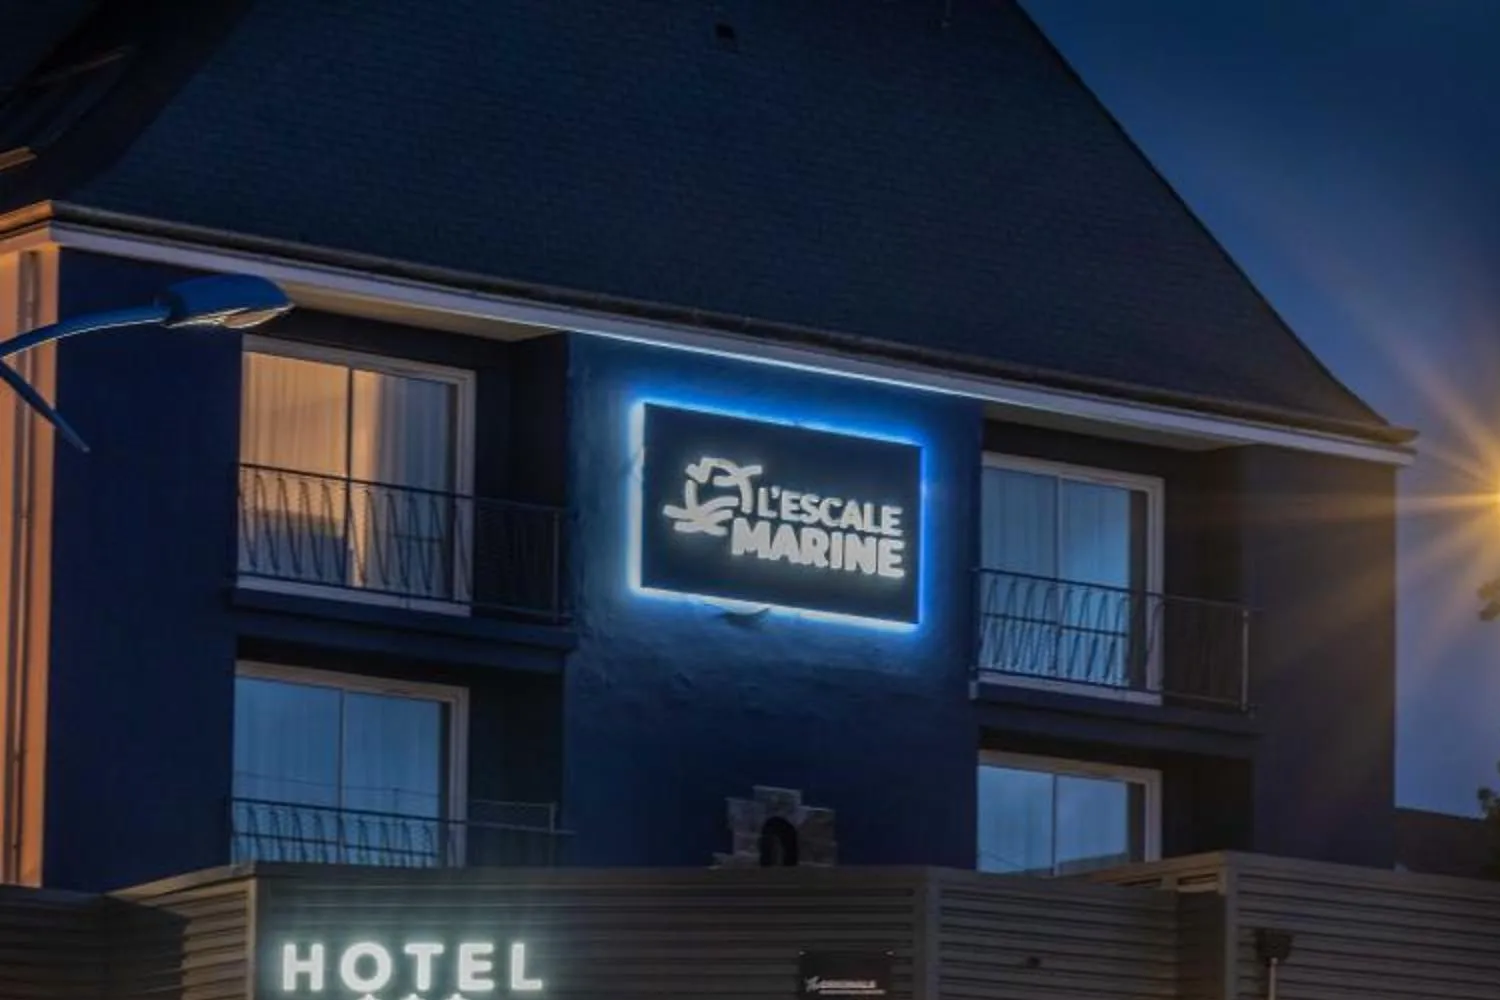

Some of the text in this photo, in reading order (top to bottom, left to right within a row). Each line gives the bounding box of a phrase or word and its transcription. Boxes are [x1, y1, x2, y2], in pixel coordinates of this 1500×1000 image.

[758, 487, 904, 536] L'ESCALE
[732, 517, 905, 578] MARINE
[282, 942, 543, 992] HOTEL
